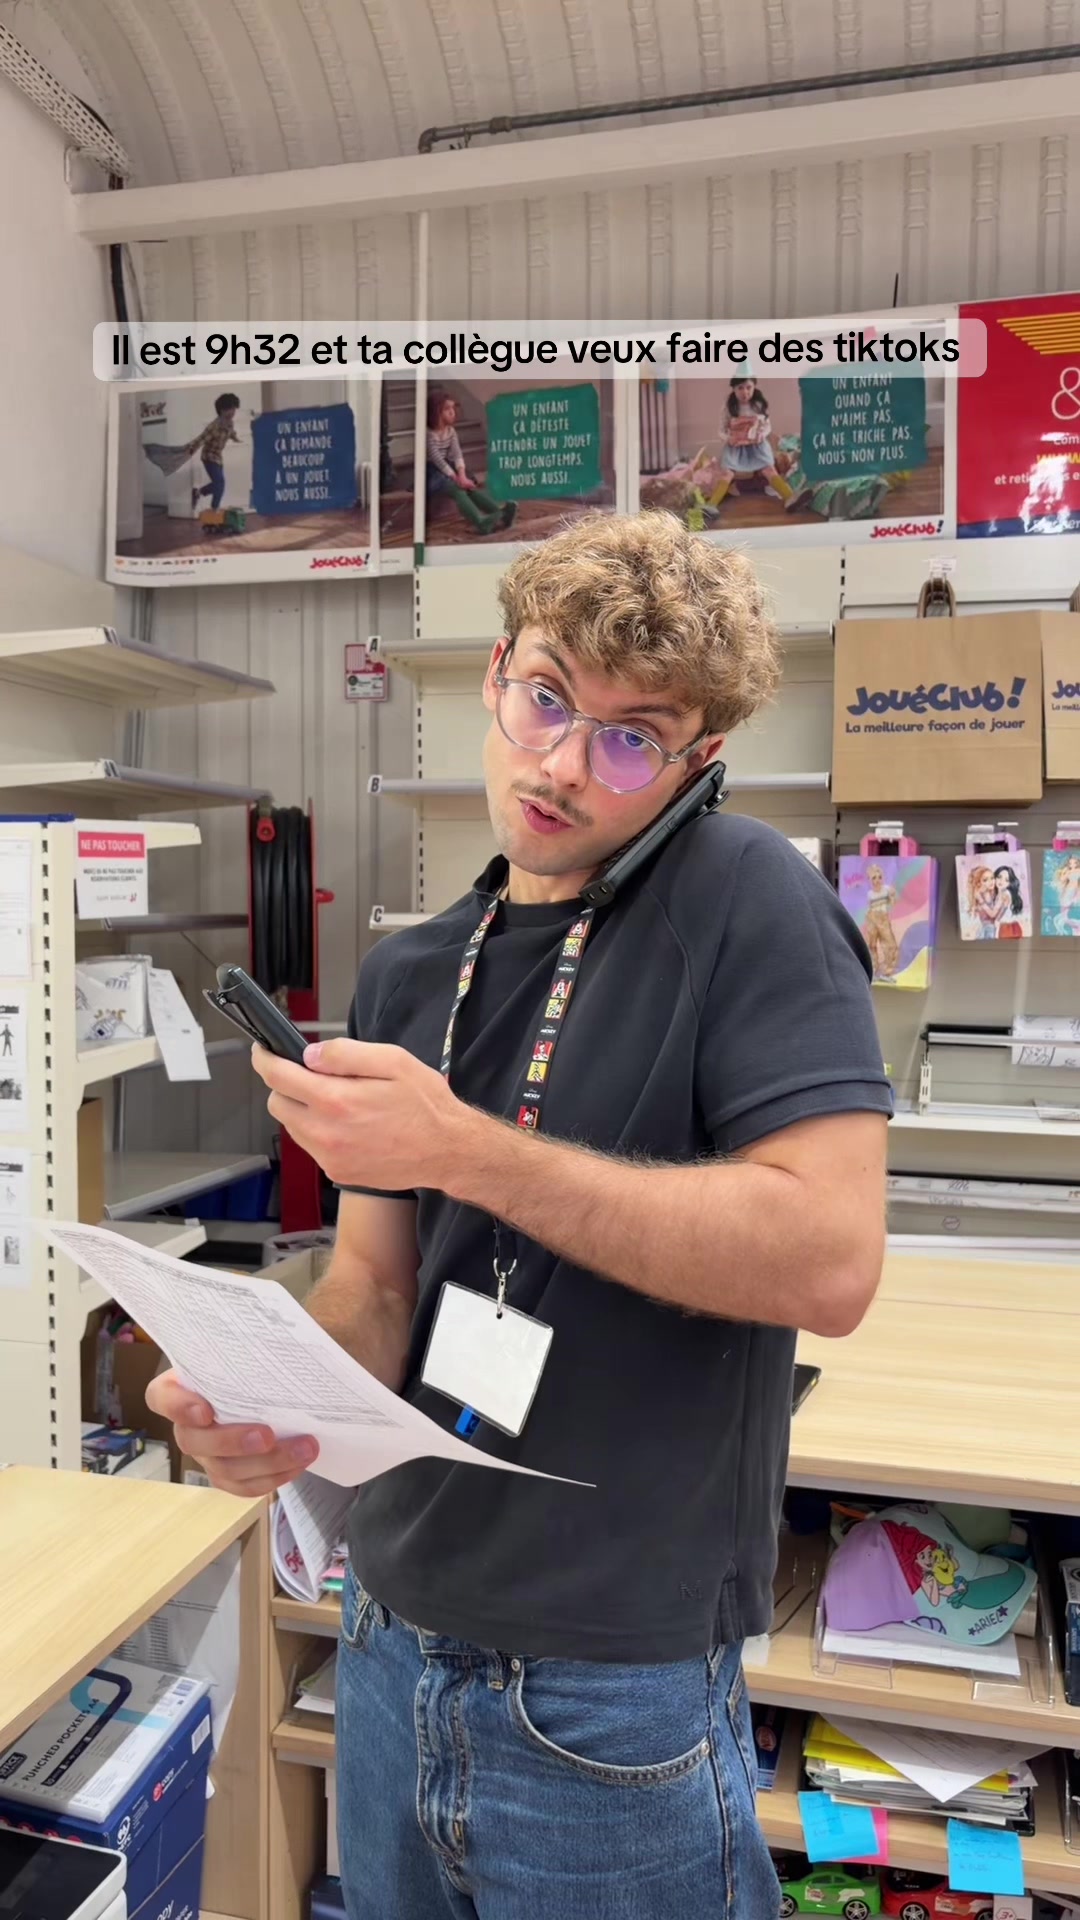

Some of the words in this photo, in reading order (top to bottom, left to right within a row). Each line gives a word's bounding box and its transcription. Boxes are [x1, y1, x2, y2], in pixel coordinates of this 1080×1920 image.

[833, 376, 847, 389] UN
[853, 373, 893, 388] ENFANT
[835, 393, 871, 408] QUAND
[877, 391, 891, 405] ÇA
[513, 404, 528, 416] UN
[533, 401, 569, 415] ENFANT
[277, 422, 291, 434] UN
[295, 419, 329, 433] ENFANT
[513, 421, 526, 436] ÇA
[531, 418, 570, 432] DÉTESTE
[831, 412, 867, 427] N'AIME
[274, 437, 287, 453] ÇA
[290, 436, 332, 450] DEMANDE
[490, 439, 538, 453] ATTENDRE
[542, 437, 557, 449] UN
[562, 434, 591, 448] JOUET
[812, 433, 826, 449] ÇA
[831, 432, 845, 446] NE
[852, 428, 886, 443] TRICHE
[282, 453, 325, 468] BEAUCOUP
[498, 456, 522, 469] TROP
[818, 450, 846, 465] NOUS
[851, 448, 875, 462] NON
[285, 472, 299, 483] UN
[510, 473, 537, 487] NOUS
[994, 474, 1007, 486] et
[275, 488, 300, 501] NOUS
[369, 637, 379, 653] A
[845, 721, 861, 734] La
[864, 719, 924, 735] meilleure
[928, 718, 966, 735] façon
[969, 719, 986, 732] de
[989, 718, 1026, 733] jouer
[370, 776, 380, 793] B
[80, 839, 92, 851] NE
[93, 839, 106, 851] PAS
[107, 839, 141, 852] TOUCHER
[374, 908, 382, 923] C
[975, 1611, 1003, 1633] ARIEL
[22, 1744, 60, 1781] PUNCHED
[56, 1709, 91, 1744] POCKETS
